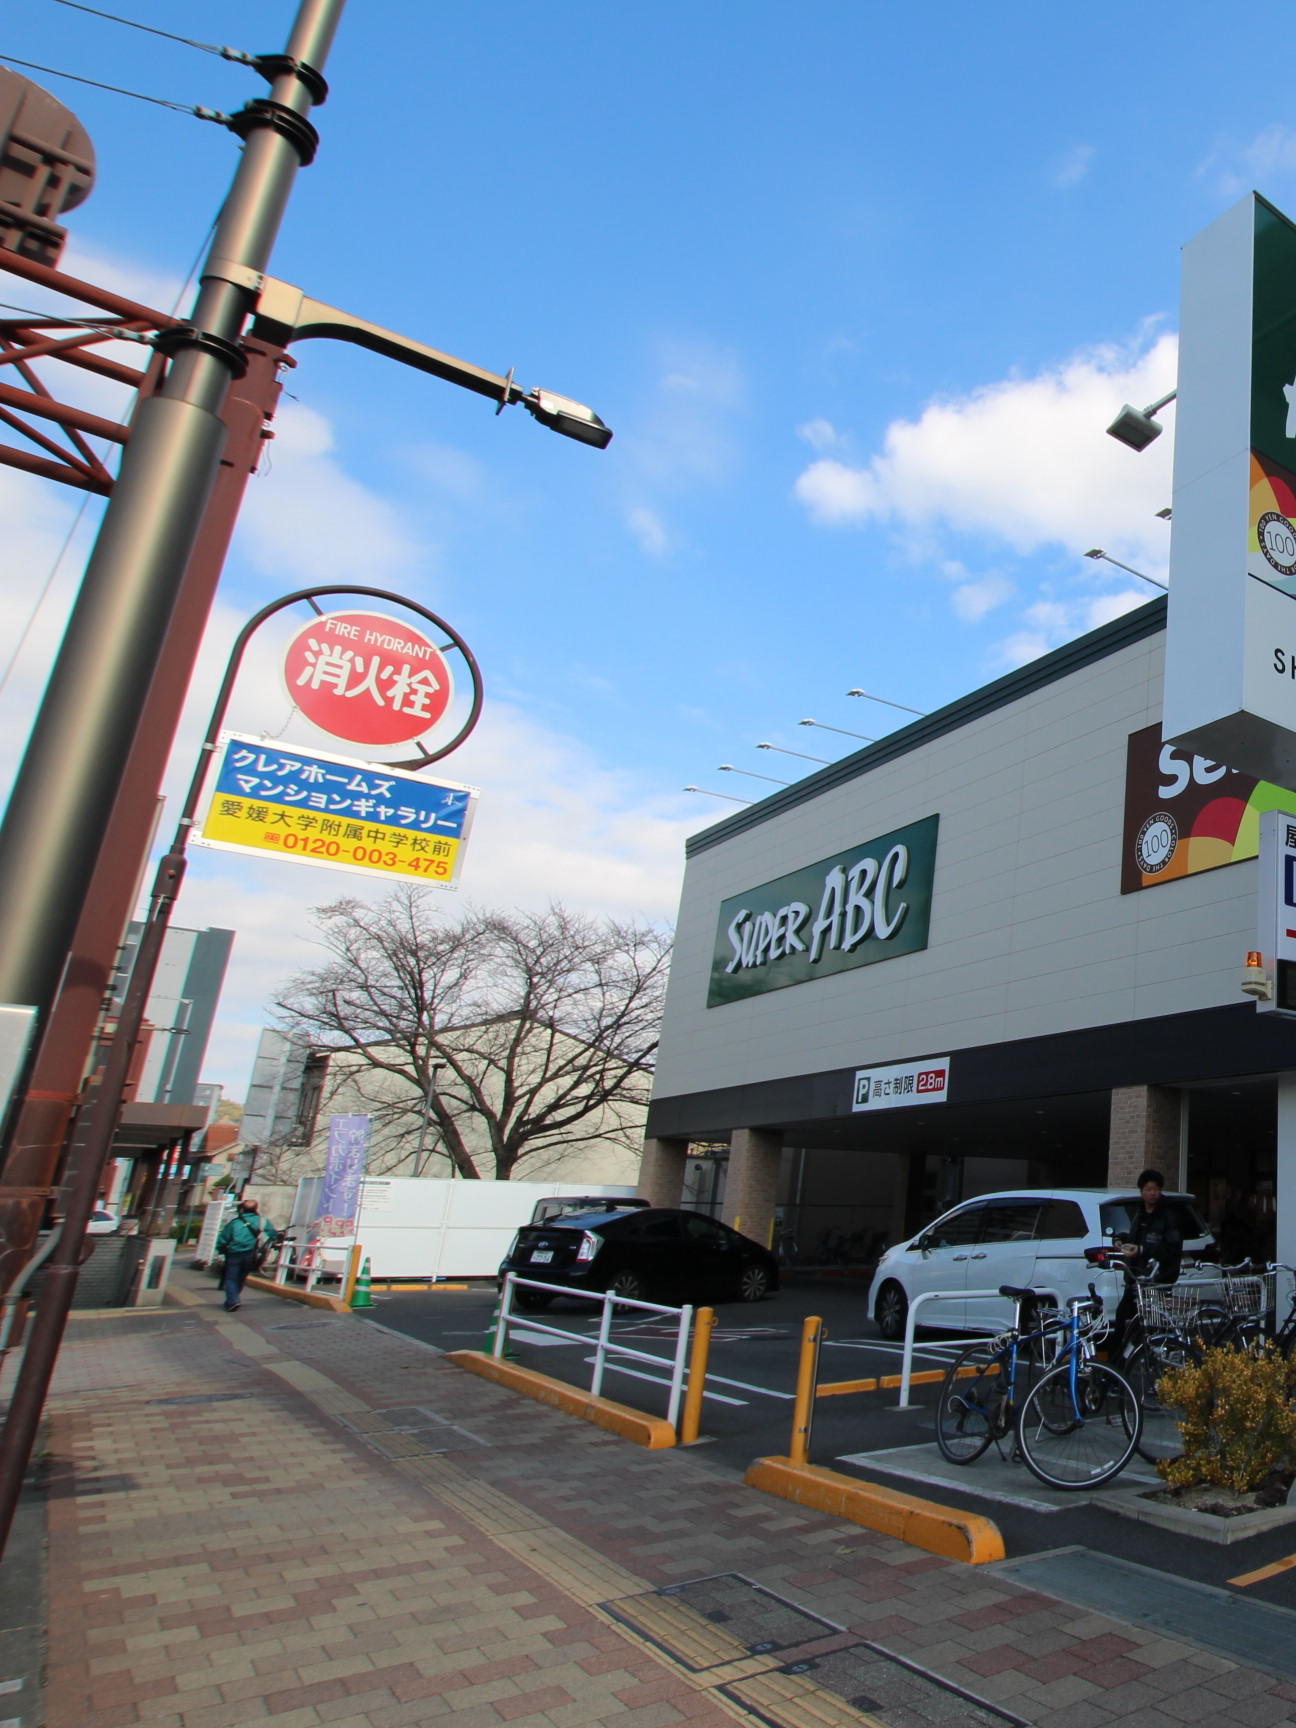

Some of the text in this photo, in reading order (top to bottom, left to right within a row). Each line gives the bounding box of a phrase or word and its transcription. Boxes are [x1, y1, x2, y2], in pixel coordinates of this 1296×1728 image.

[1265, 513, 1277, 521] YEN
[1260, 542, 1275, 565] DAYS
[1266, 530, 1295, 557] 100
[324, 618, 433, 661] FIRE HYDRANT
[296, 637, 440, 720] 消火栓
[231, 748, 397, 798] クレアホームズ
[235, 773, 458, 829] マンションギャラリー
[218, 798, 453, 858] 愛媛大学附属中学校前
[1155, 815, 1175, 829] GOODS
[282, 832, 449, 877] 0120-003-475
[1144, 829, 1169, 859] 100
[1164, 834, 1177, 863] COLOR
[724, 844, 909, 975] SUPER ABC
[872, 1074, 915, 1099] 高さ制限
[918, 1072, 945, 1091] 2.8m
